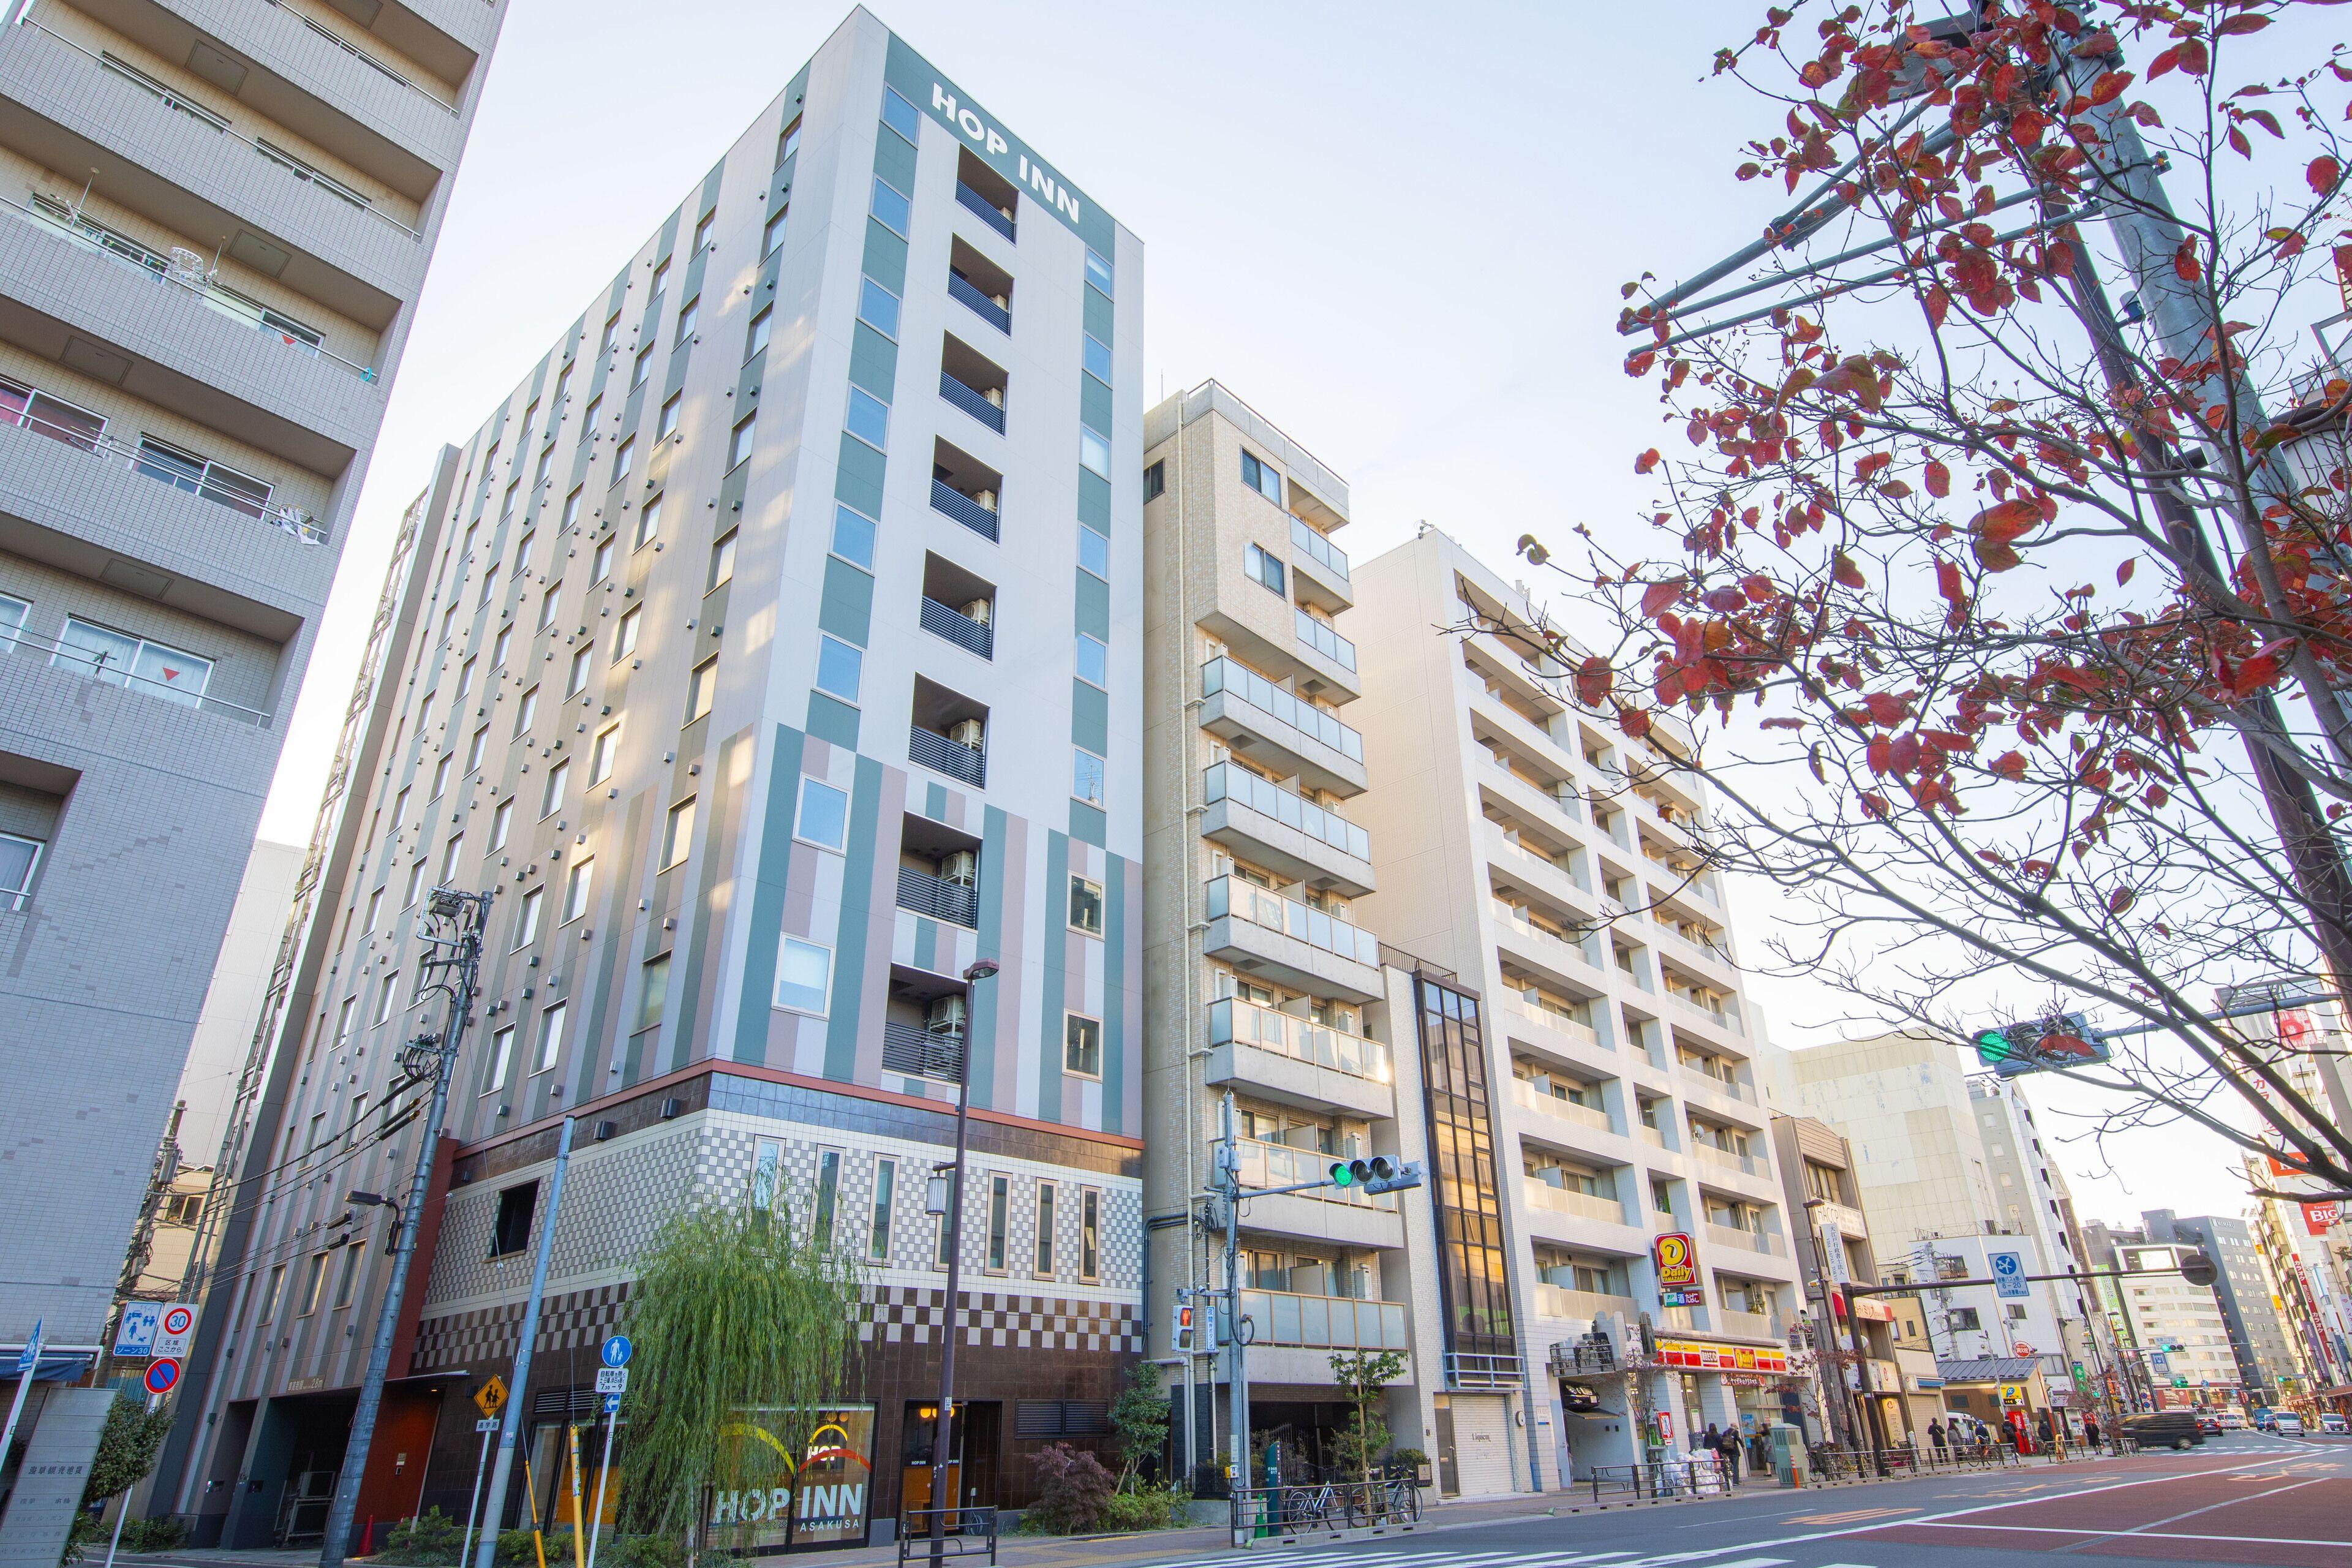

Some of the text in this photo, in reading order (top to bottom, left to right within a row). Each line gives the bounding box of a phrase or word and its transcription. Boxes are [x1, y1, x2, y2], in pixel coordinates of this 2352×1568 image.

[932, 82, 1079, 224] HOP INN
[2310, 1210, 2338, 1223] BIG
[1662, 1266, 1692, 1281] Daily
[1685, 1293, 1700, 1303] たばこ
[2294, 1260, 2305, 1281] カラオケ
[2312, 1311, 2323, 1333] カラオケ
[170, 1315, 186, 1328] 30
[713, 1483, 863, 1524] HOP INN
[800, 1519, 859, 1532] ASAKUSA
